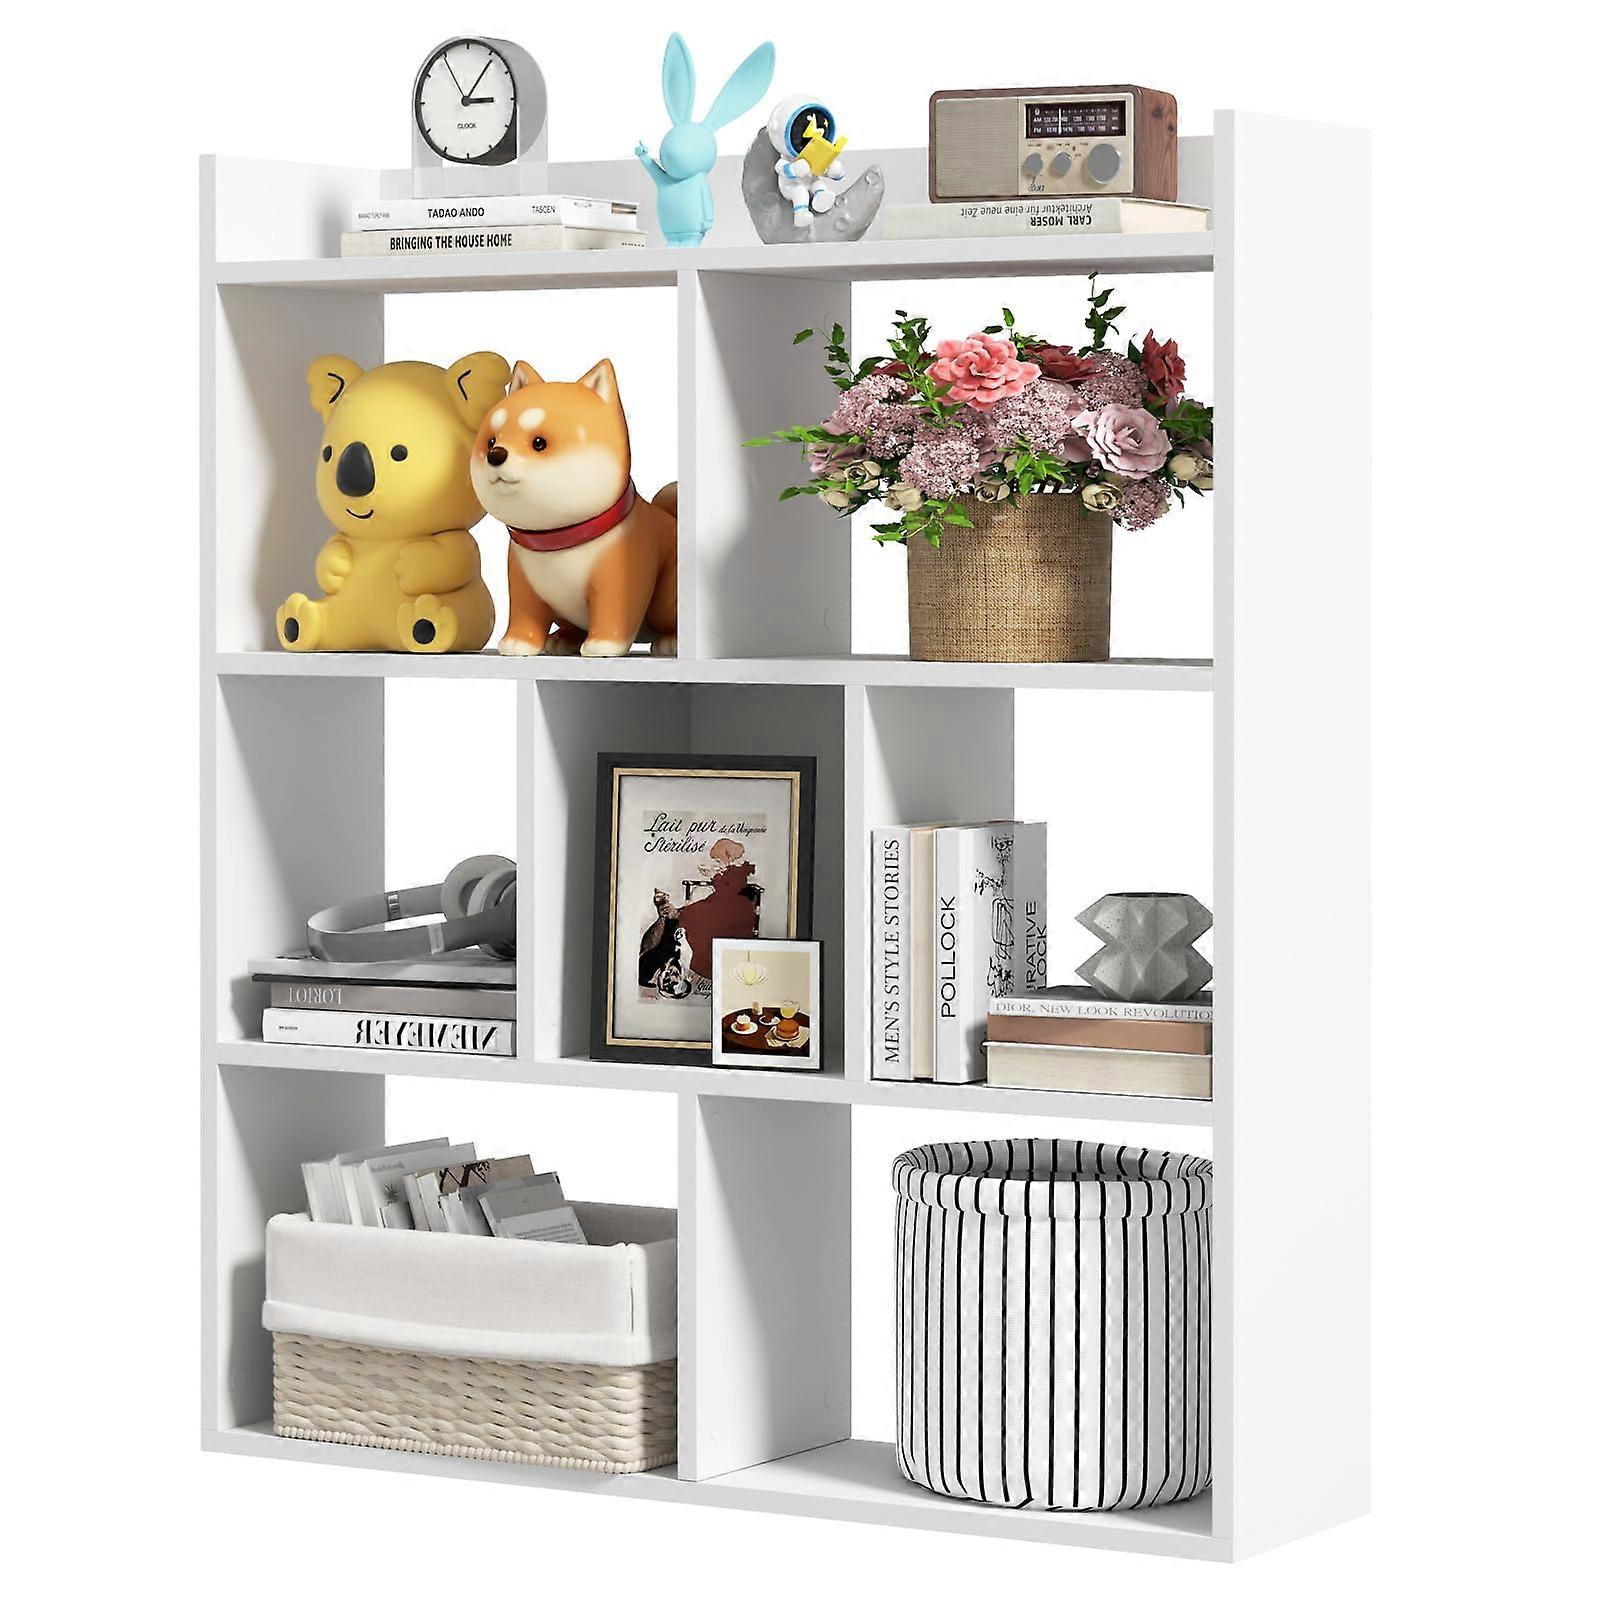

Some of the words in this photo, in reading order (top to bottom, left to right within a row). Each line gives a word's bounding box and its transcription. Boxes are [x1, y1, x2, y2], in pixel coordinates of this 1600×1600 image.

[427, 208, 457, 219] TADAO
[459, 207, 485, 218] ANDO
[960, 208, 978, 218] Zeit
[980, 207, 1001, 216] neue
[1004, 206, 1024, 217] eine
[1026, 205, 1040, 217] für
[1041, 203, 1093, 215] Architektur
[1030, 215, 1063, 227] MOSER
[1067, 214, 1092, 226] CARL
[390, 235, 433, 251] BRINGING
[435, 234, 453, 250] THE
[454, 233, 485, 249] HOUSE
[487, 232, 512, 247] HOME
[643, 812, 682, 832] Lait
[686, 820, 717, 837] pur
[884, 839, 900, 925] STORIES
[885, 931, 900, 995] STYLE
[941, 896, 957, 1018] POLLOCK
[289, 986, 342, 1005] LORIOT
[1040, 1004, 1072, 1014] NEW
[1078, 1006, 1118, 1016] LOOK
[885, 1000, 900, 1064] MEN'S
